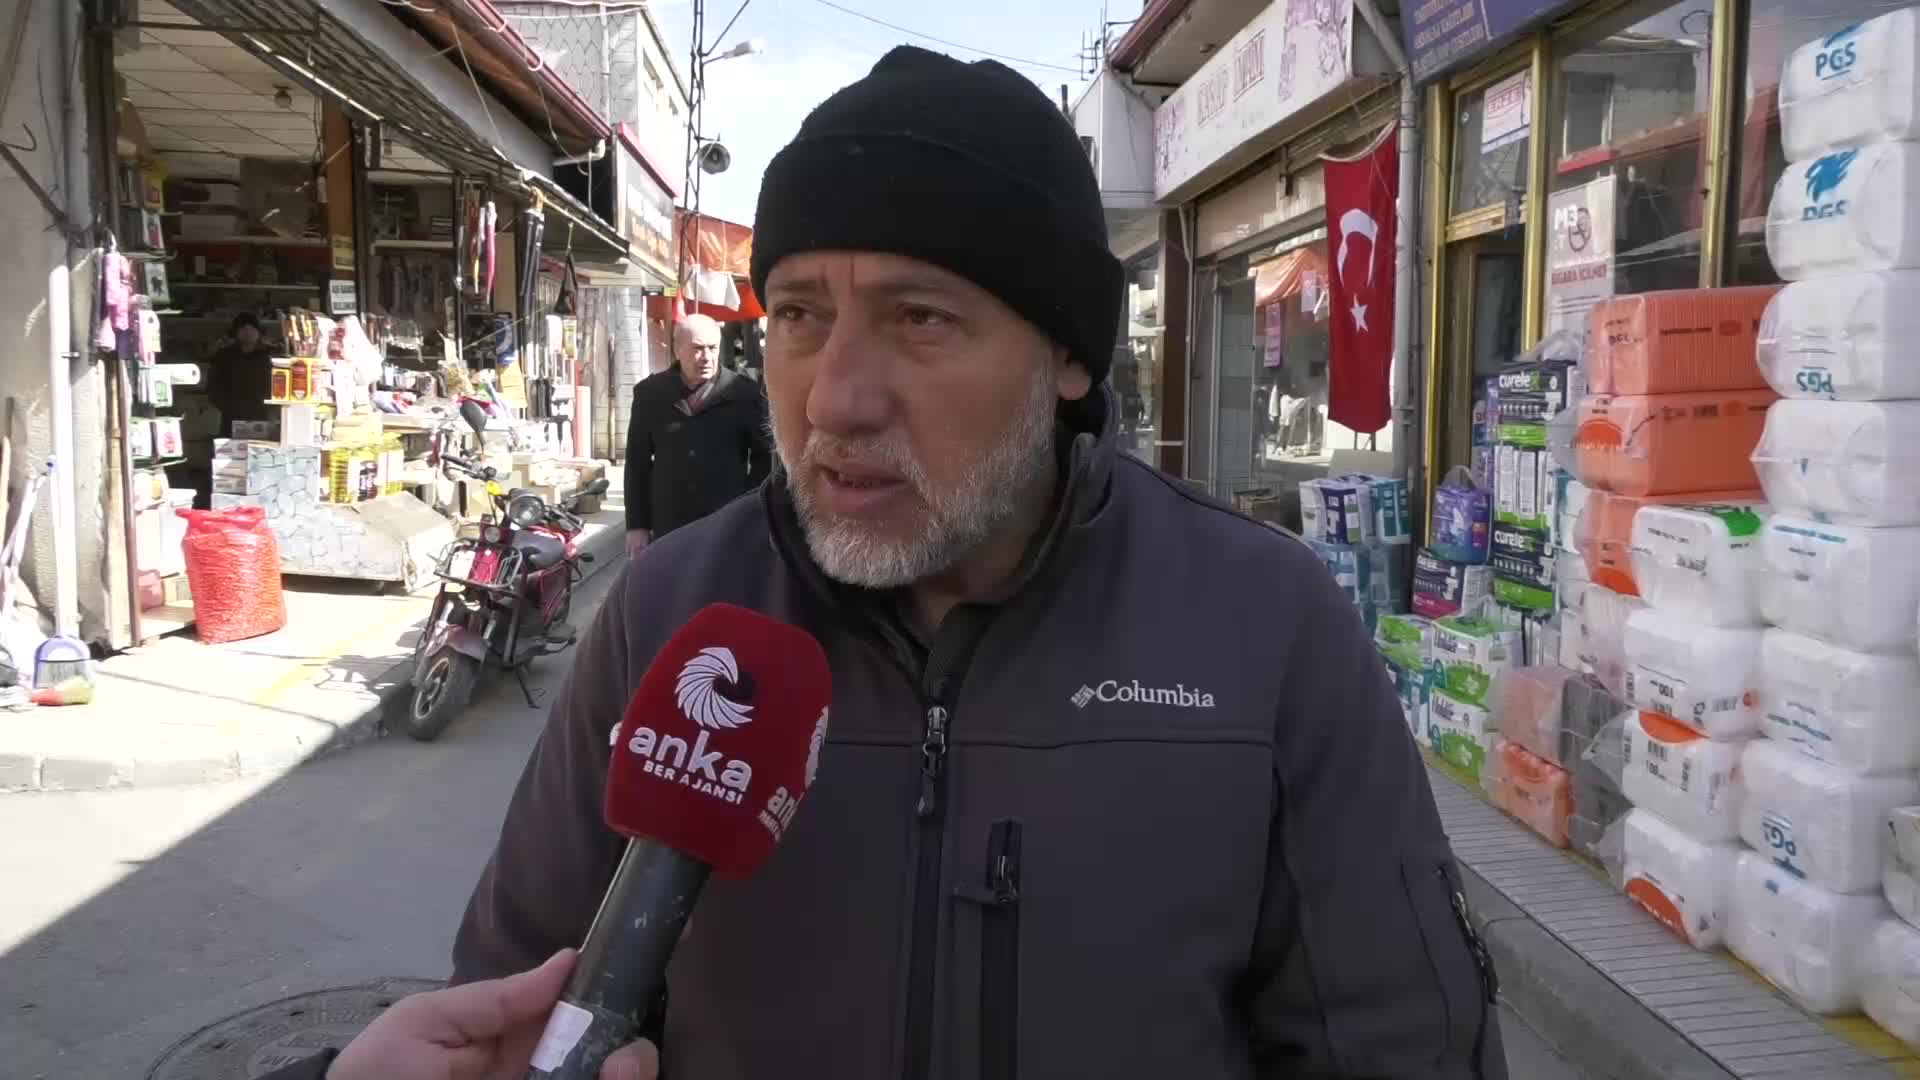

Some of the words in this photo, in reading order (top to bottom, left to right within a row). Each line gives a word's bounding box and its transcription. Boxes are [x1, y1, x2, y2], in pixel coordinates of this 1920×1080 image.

[1815, 41, 1856, 77] PGS
[1796, 371, 1835, 393] PGS
[1096, 680, 1216, 708] Columbia
[629, 726, 752, 793] anka
